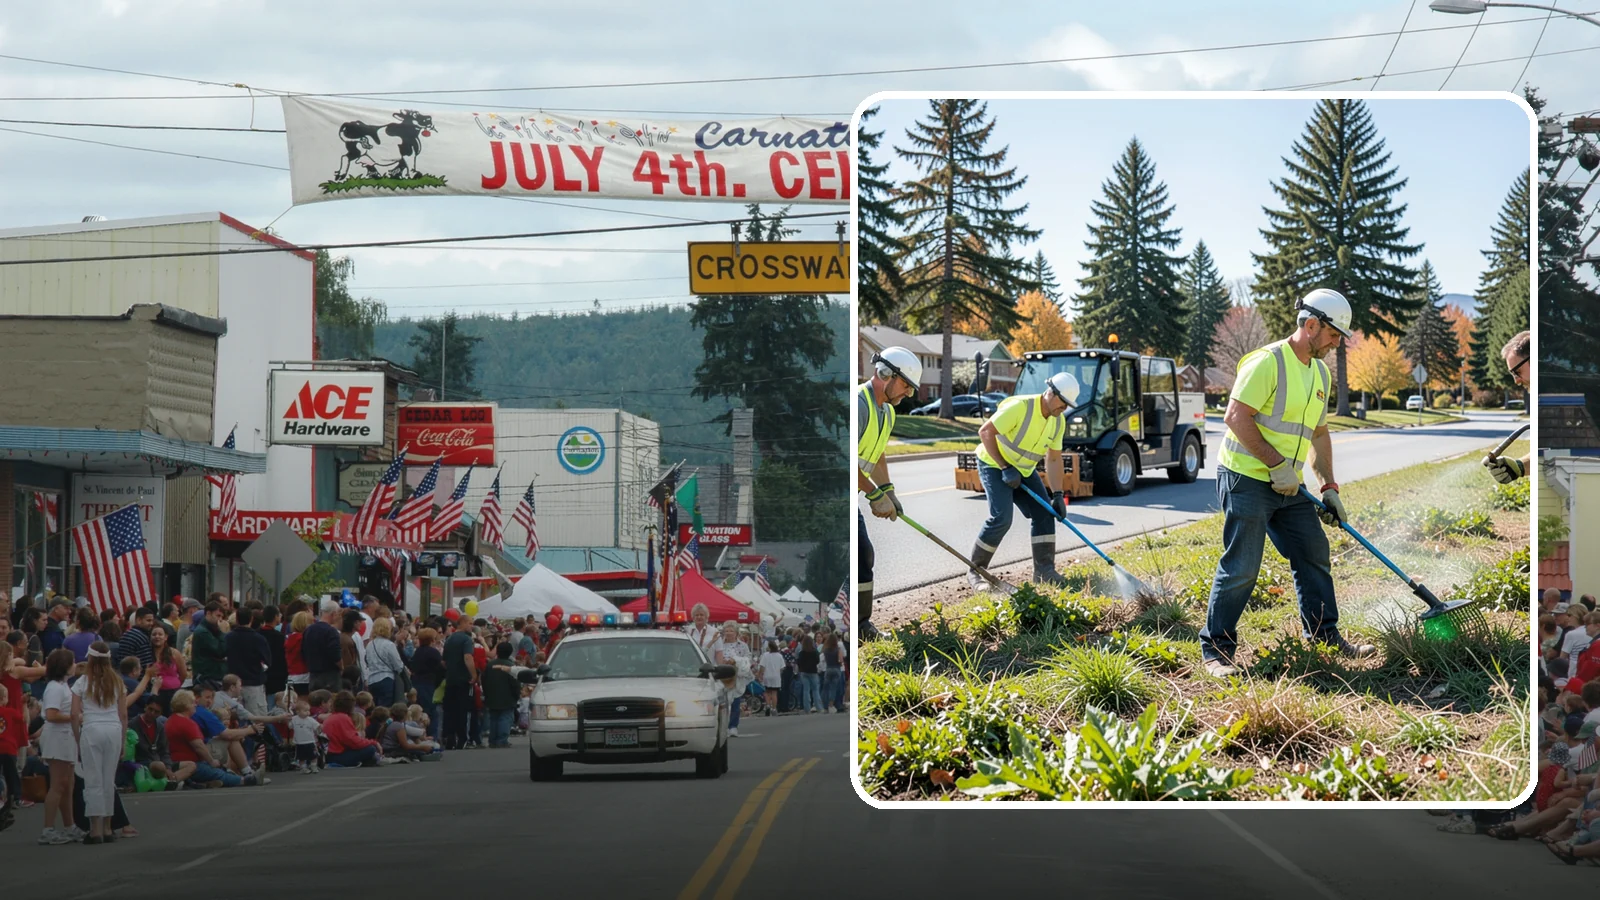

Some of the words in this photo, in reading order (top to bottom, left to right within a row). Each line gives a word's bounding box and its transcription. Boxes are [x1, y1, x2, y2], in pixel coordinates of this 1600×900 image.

[481, 140, 605, 193] JULY
[632, 149, 747, 199] 4th.
[696, 254, 850, 280] CROSSWA
[283, 380, 373, 420] ACE
[405, 409, 452, 422] CEDAR
[461, 409, 485, 422] LOG
[283, 420, 371, 437] Hardware
[416, 428, 477, 447] Coca-Cola
[353, 467, 385, 480] Simpl
[83, 485, 93, 494] St.
[95, 484, 124, 495] Vincent
[126, 485, 136, 495] de
[137, 485, 155, 496] Paul
[688, 526, 741, 535] CRNATION
[699, 535, 730, 543] GLASS
